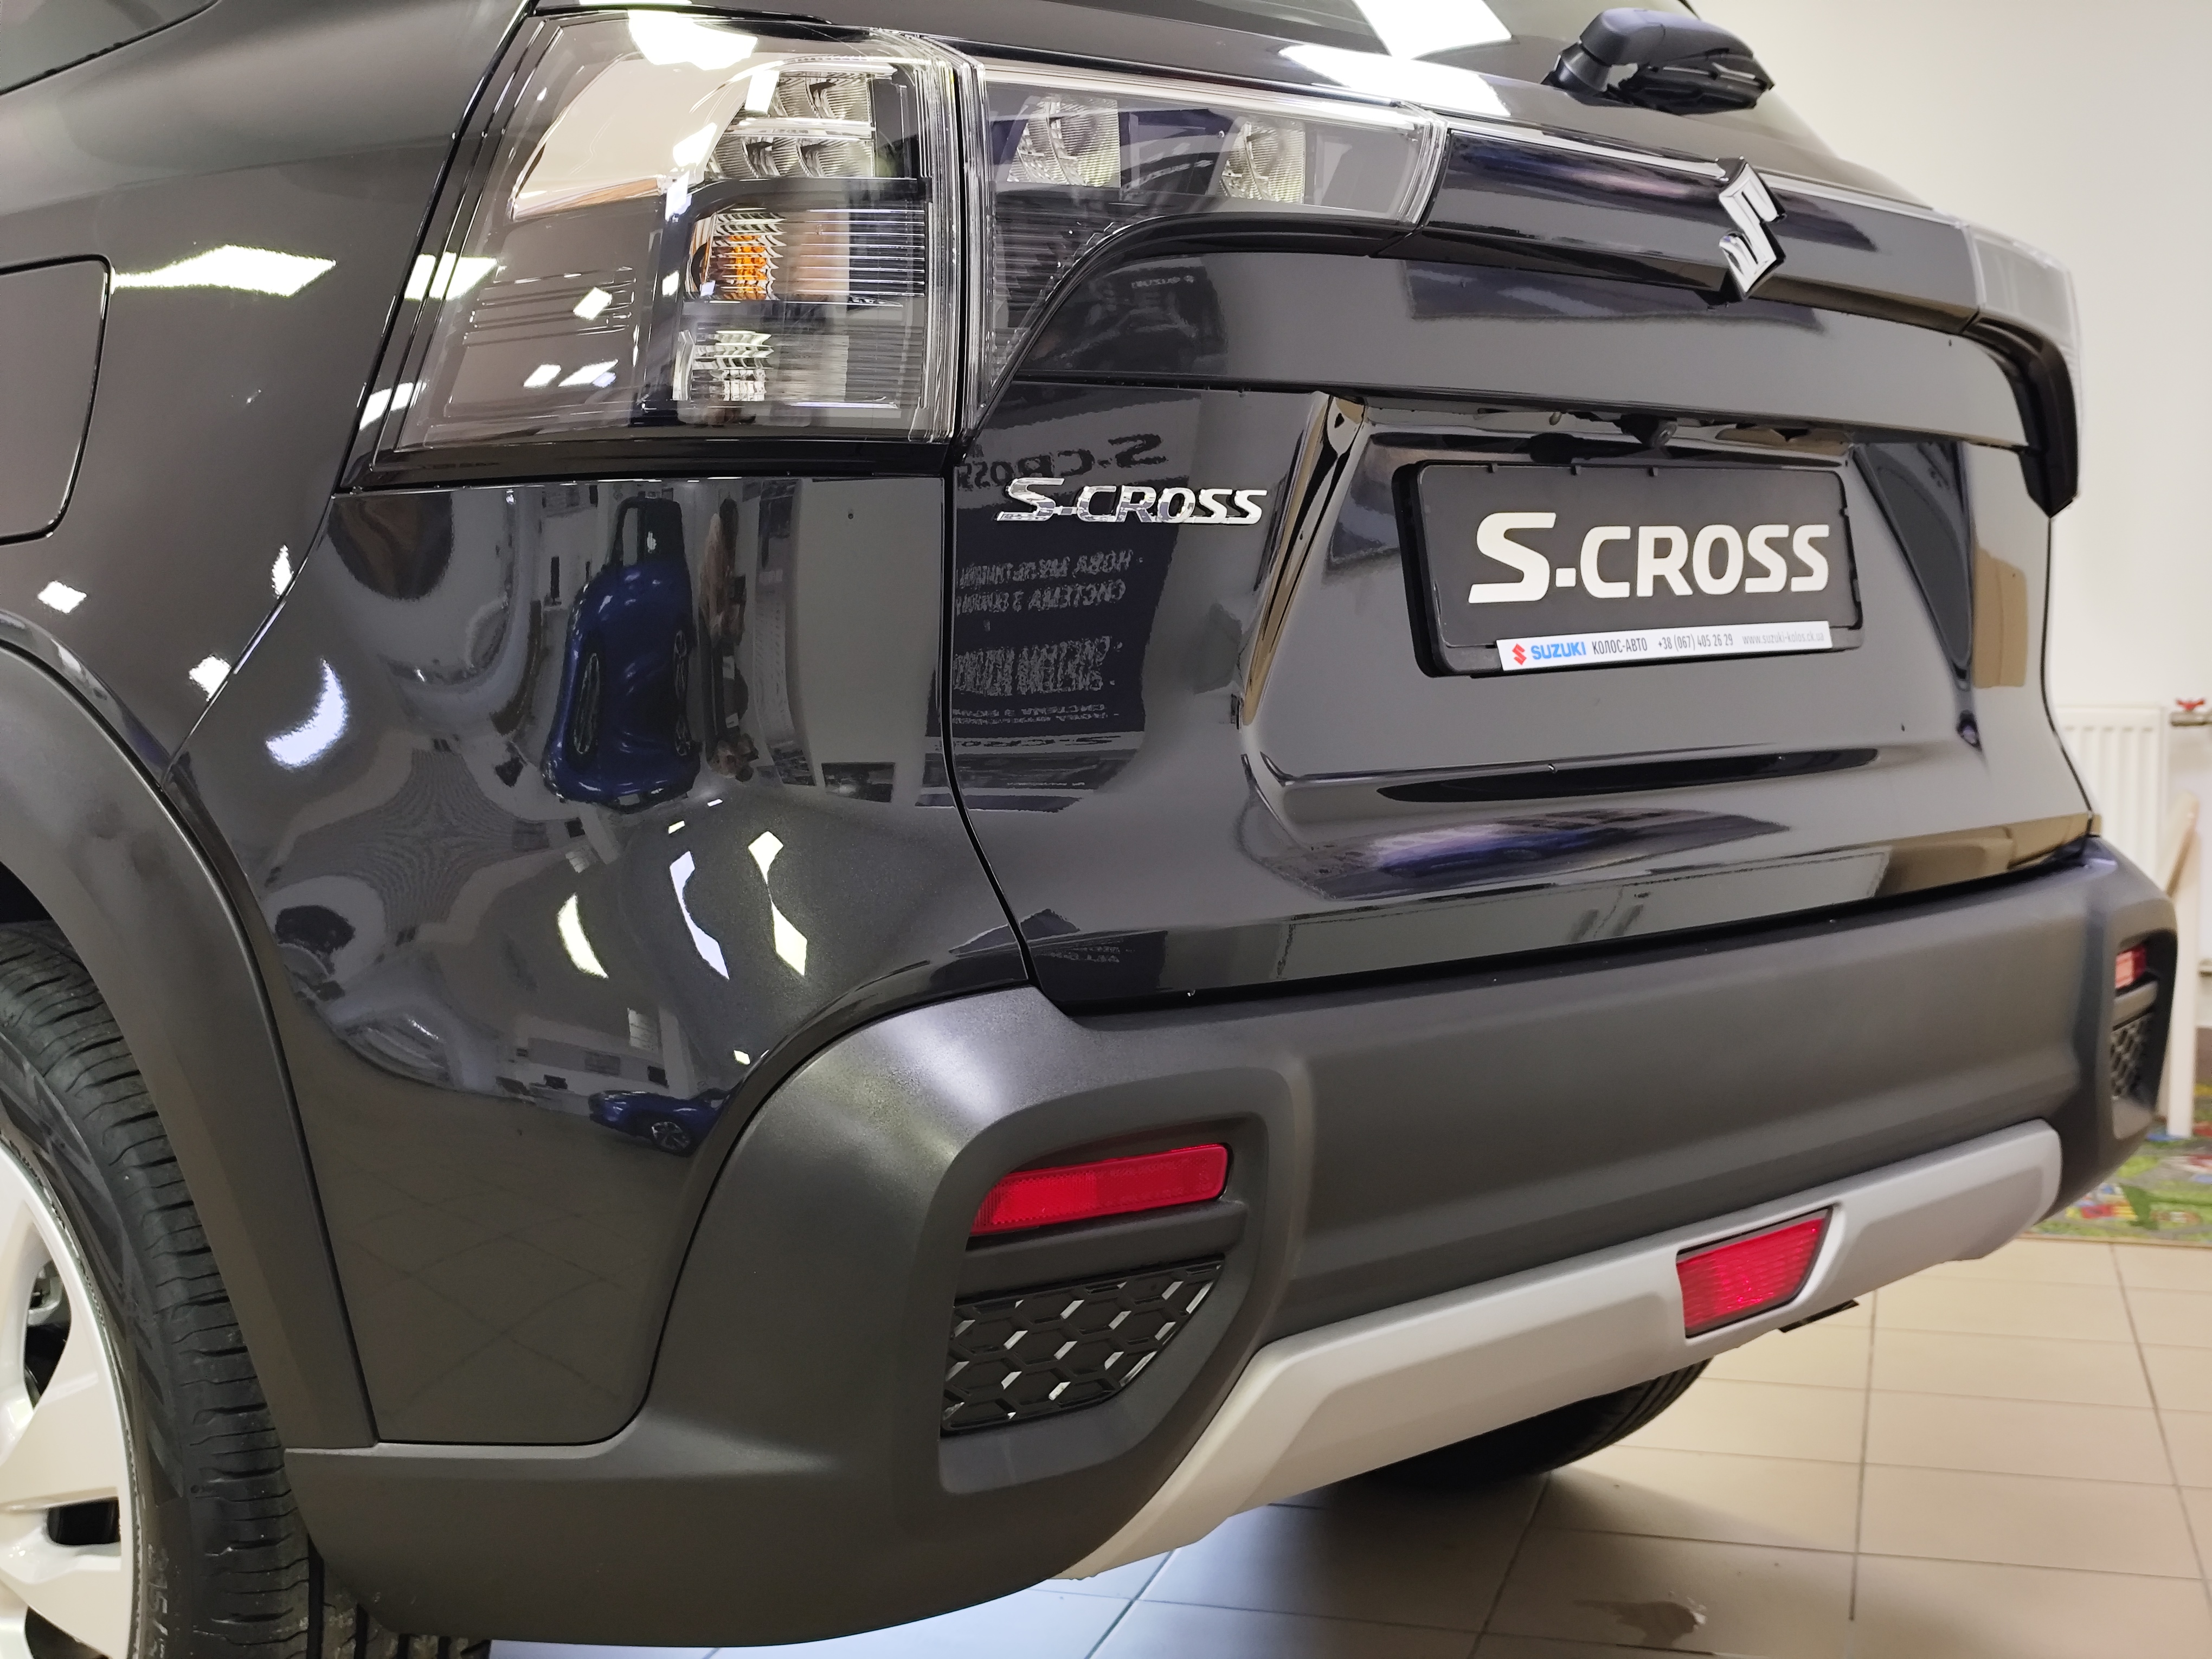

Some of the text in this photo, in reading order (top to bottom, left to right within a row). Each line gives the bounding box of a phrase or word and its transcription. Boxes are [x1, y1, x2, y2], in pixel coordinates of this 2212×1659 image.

[996, 478, 1268, 524] S-CROSS
[1468, 512, 1830, 603] S-CROSS
[1531, 641, 1586, 660] SUZUKI
[1592, 638, 1648, 655] КОЛОС-АВТО
[1658, 636, 1672, 650] +38
[1674, 633, 1695, 652] (067)
[1697, 634, 1711, 647] 405
[1712, 634, 1721, 646] 26
[1724, 633, 1733, 646] 29
